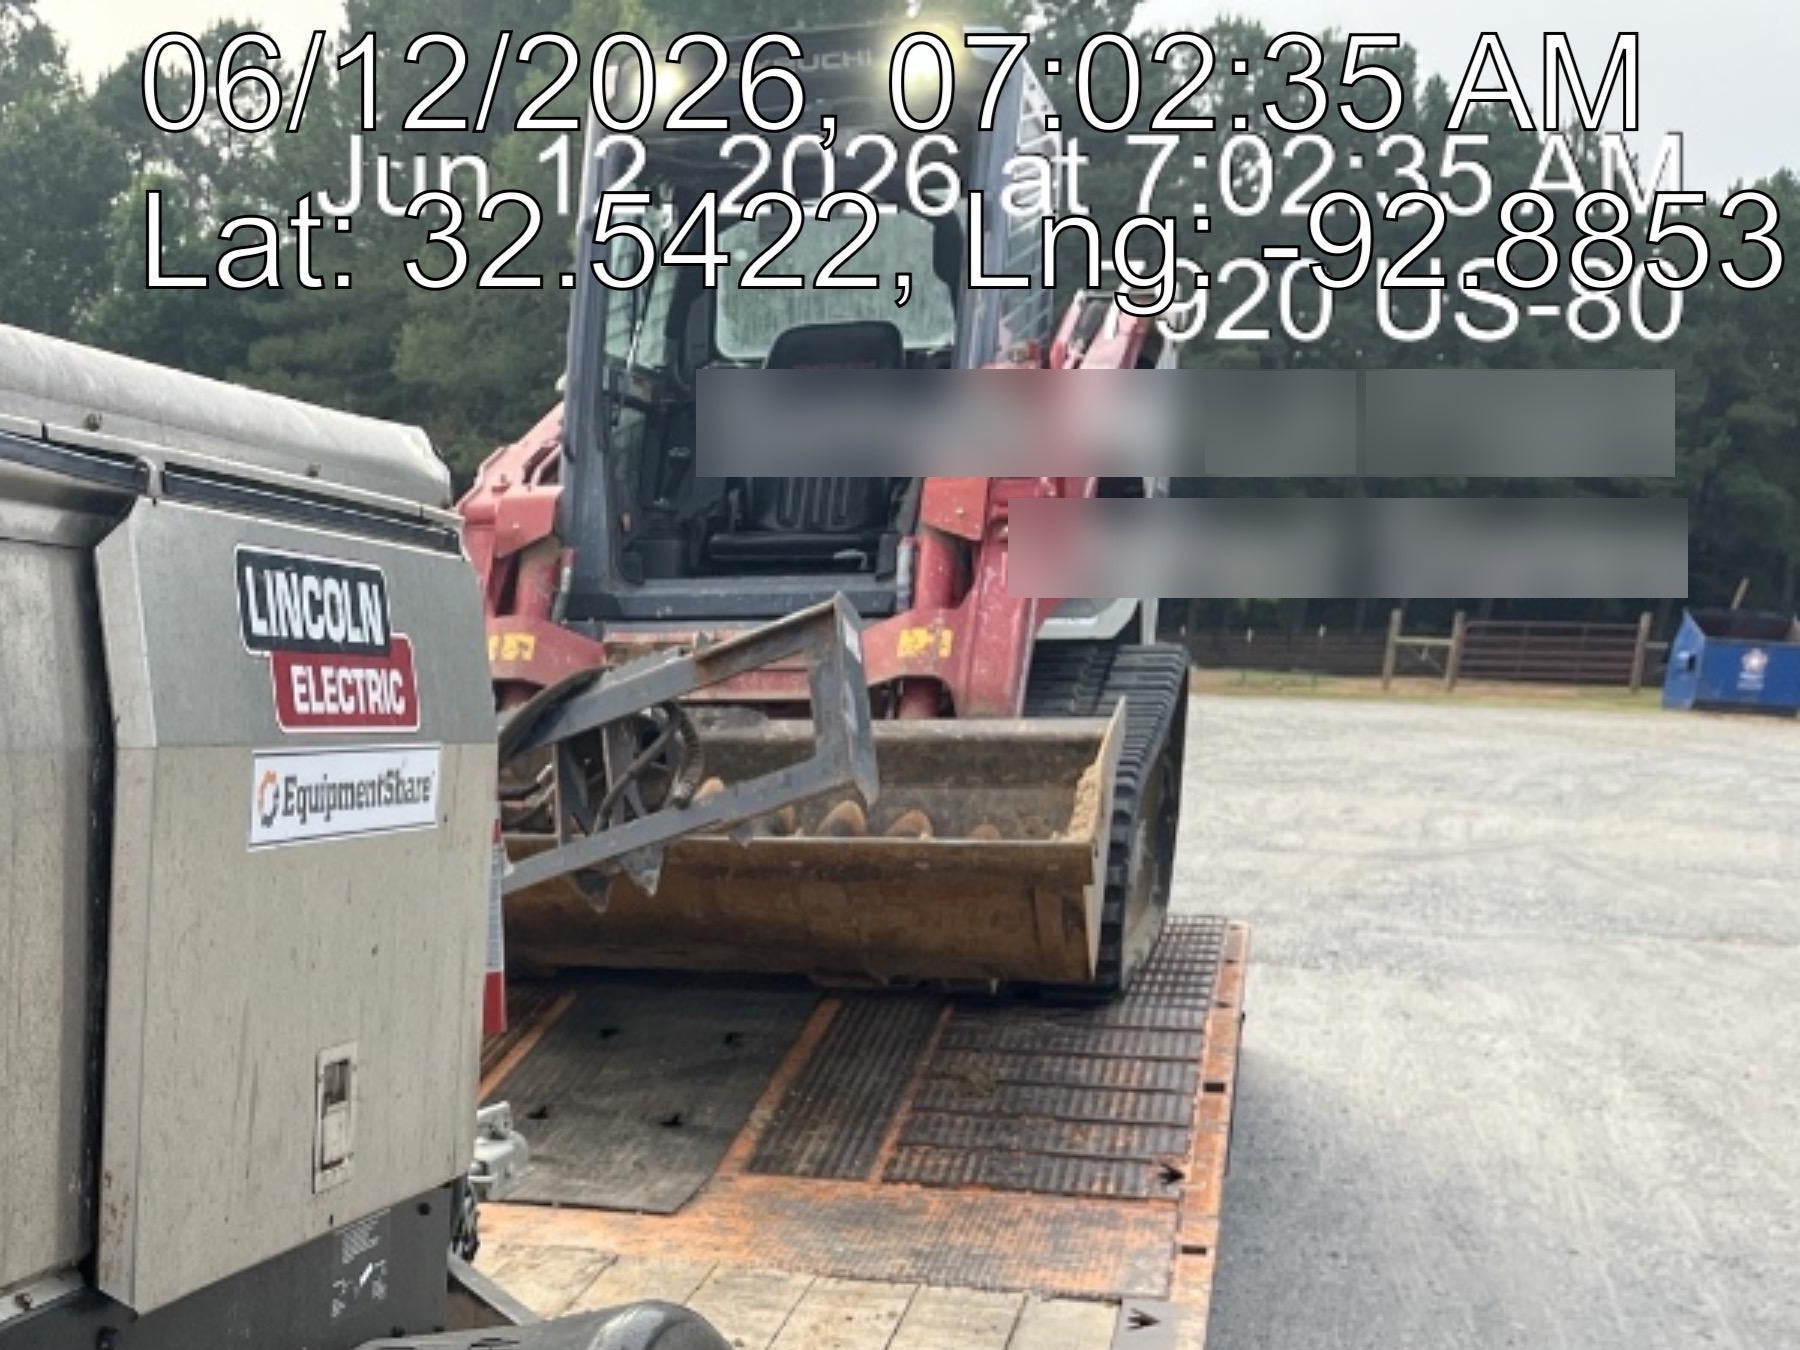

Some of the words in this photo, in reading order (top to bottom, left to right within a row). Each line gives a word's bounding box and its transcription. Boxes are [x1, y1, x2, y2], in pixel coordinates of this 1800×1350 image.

[246, 567, 386, 647] LINCOLN
[290, 664, 407, 717] ELECTRIC
[281, 769, 431, 824] EquipmentShare
